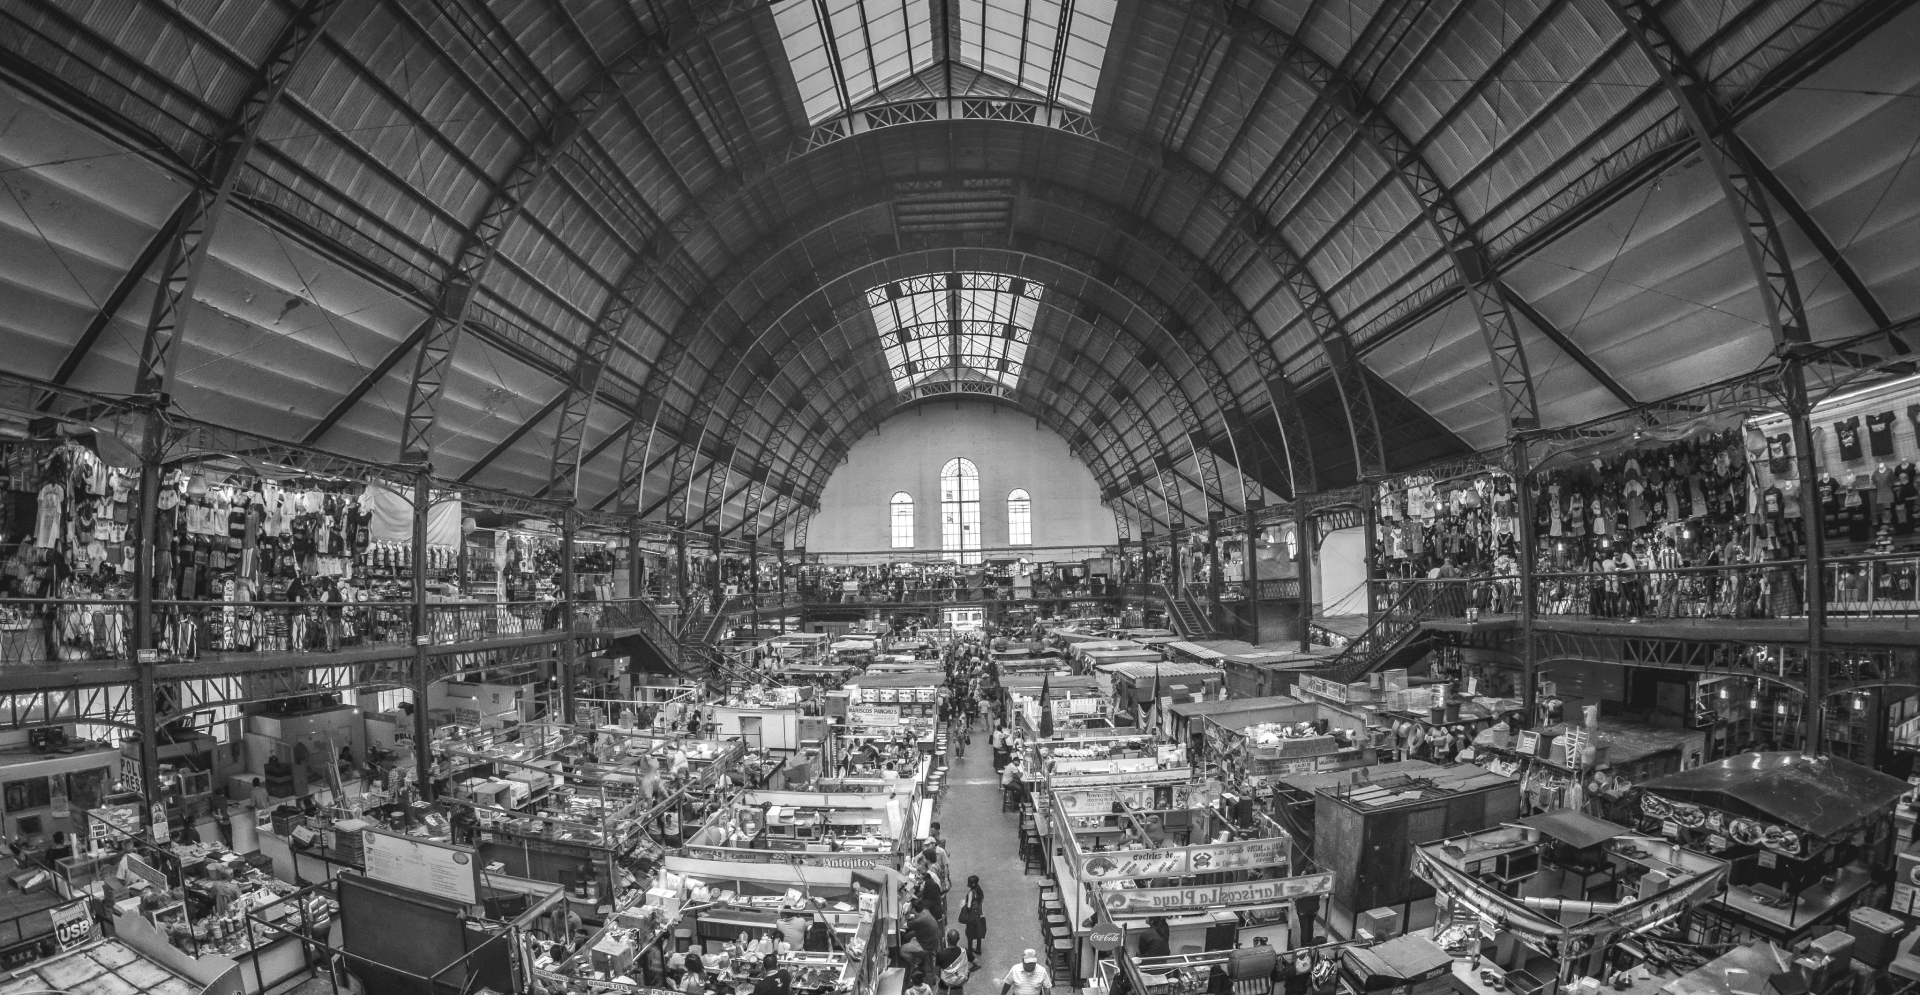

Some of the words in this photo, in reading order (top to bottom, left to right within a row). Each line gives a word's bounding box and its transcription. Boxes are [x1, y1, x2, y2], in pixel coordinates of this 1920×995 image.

[848, 707, 873, 715] MARISCOS
[394, 732, 416, 743] POLL
[1133, 852, 1162, 861] Cocteles
[824, 857, 875, 869] Antojitos
[60, 920, 91, 942] USB
